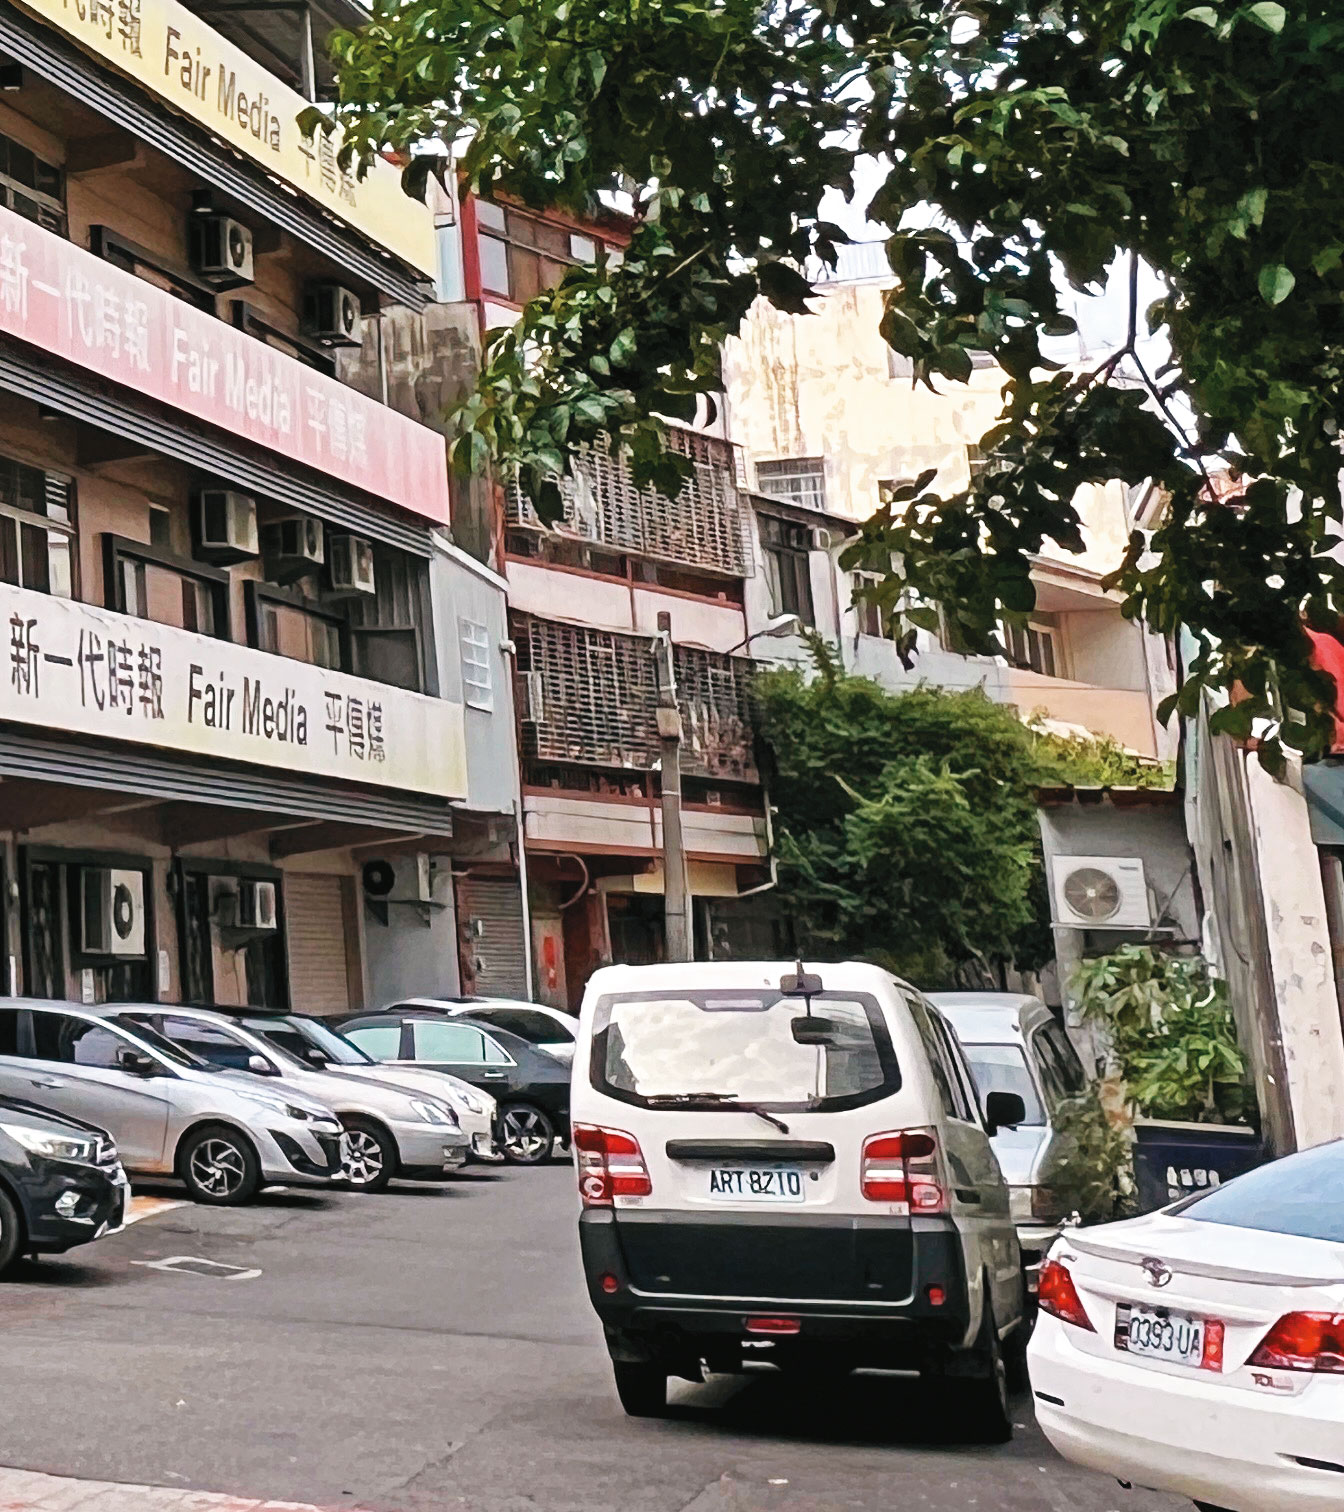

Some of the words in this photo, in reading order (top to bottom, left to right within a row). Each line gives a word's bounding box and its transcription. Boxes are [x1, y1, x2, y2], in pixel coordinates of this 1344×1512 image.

[165, 25, 212, 104] Fair
[217, 63, 281, 152] Media
[0, 228, 152, 376] 新一代時報
[170, 326, 220, 400] Fair
[224, 351, 292, 436] Media
[10, 610, 165, 720] 新一代時報
[188, 663, 235, 734] Fair
[243, 676, 308, 746] Media
